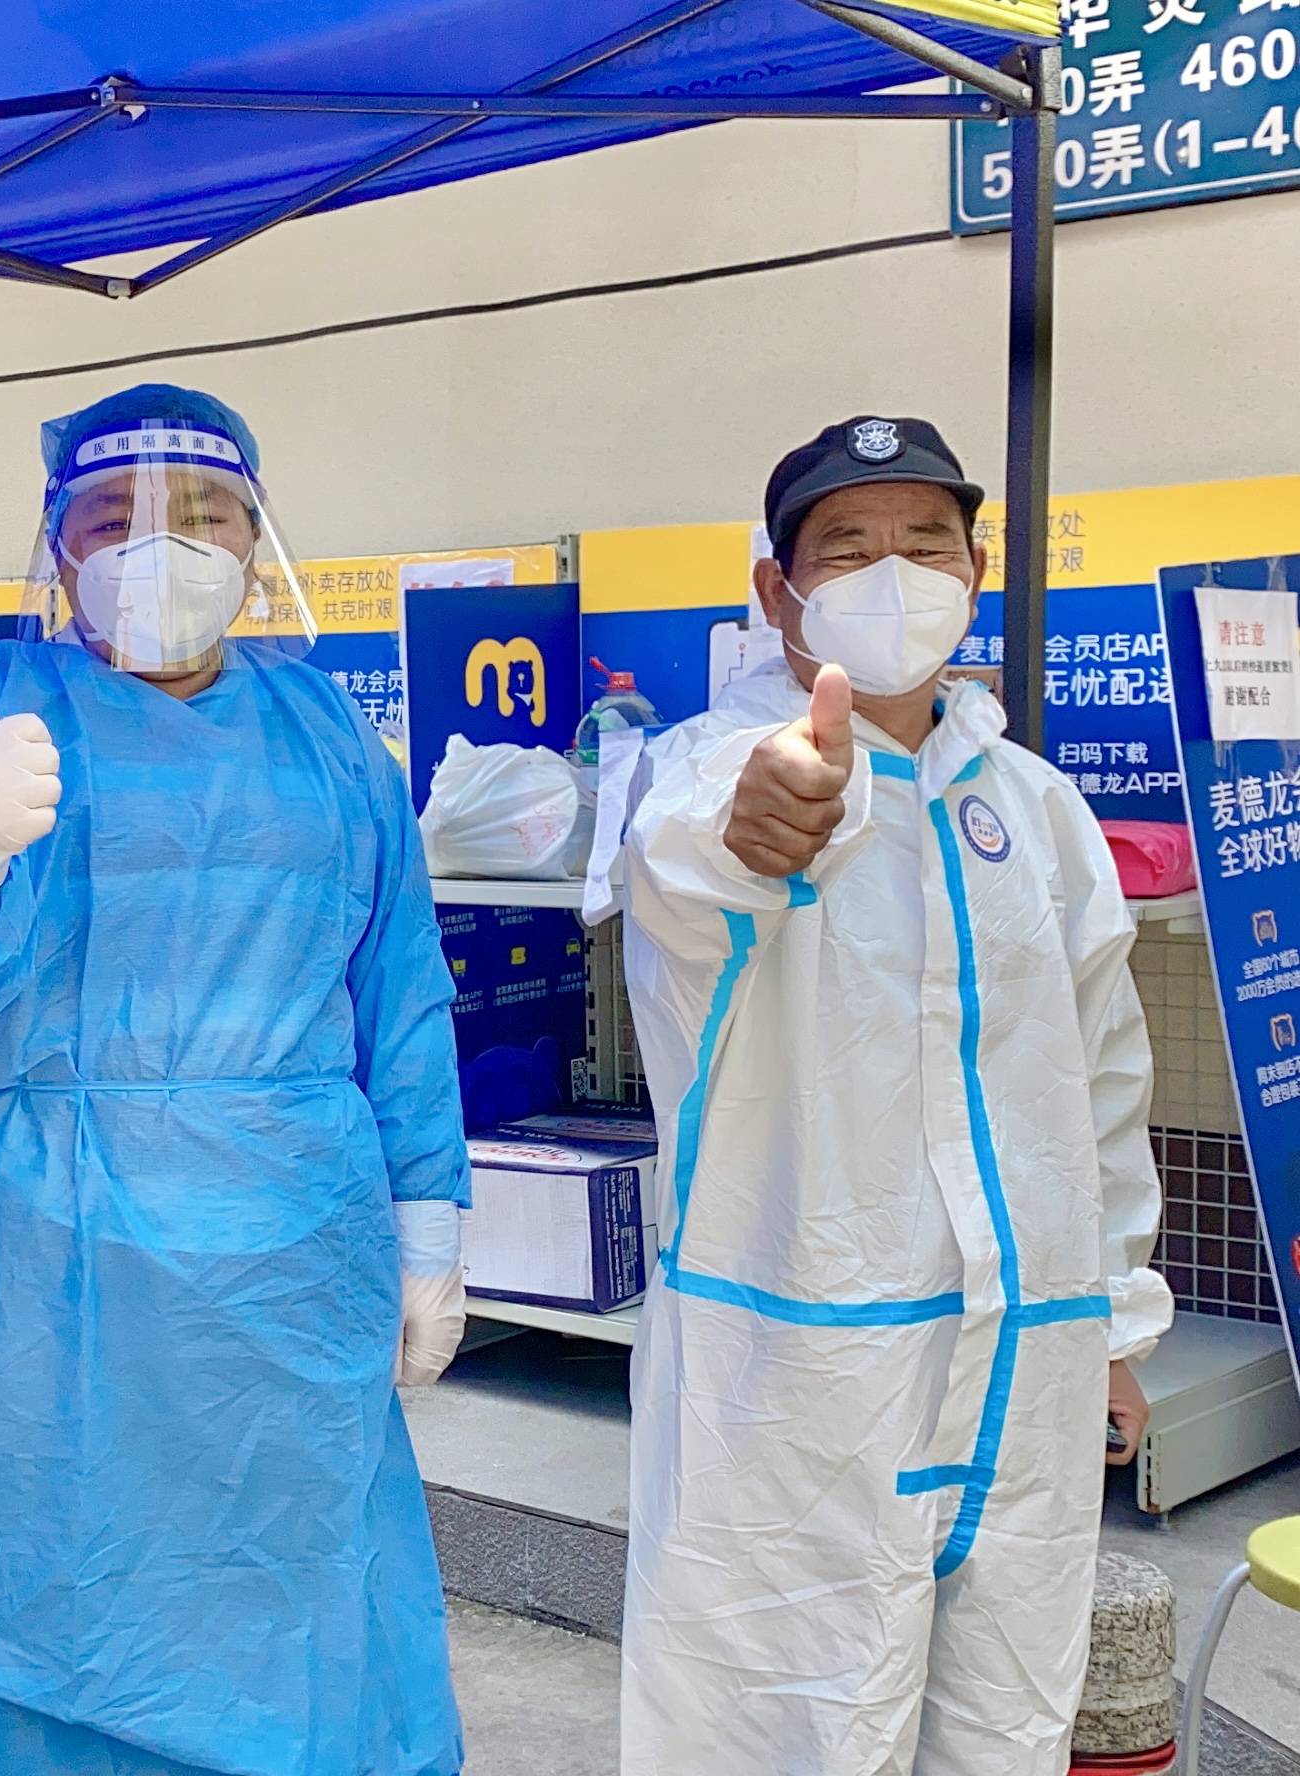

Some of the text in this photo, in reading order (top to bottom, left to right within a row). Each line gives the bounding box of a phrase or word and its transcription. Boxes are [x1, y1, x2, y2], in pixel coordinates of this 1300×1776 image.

[1180, 28, 1296, 92] 460
[93, 434, 226, 456] 医用隔离面罩
[323, 598, 394, 623] 共克时艰
[1219, 620, 1266, 646] 请注意
[1044, 667, 1172, 706] 无忧配送
[1225, 686, 1271, 706] 谢谢配合
[1058, 742, 1149, 765] 扫码下载
